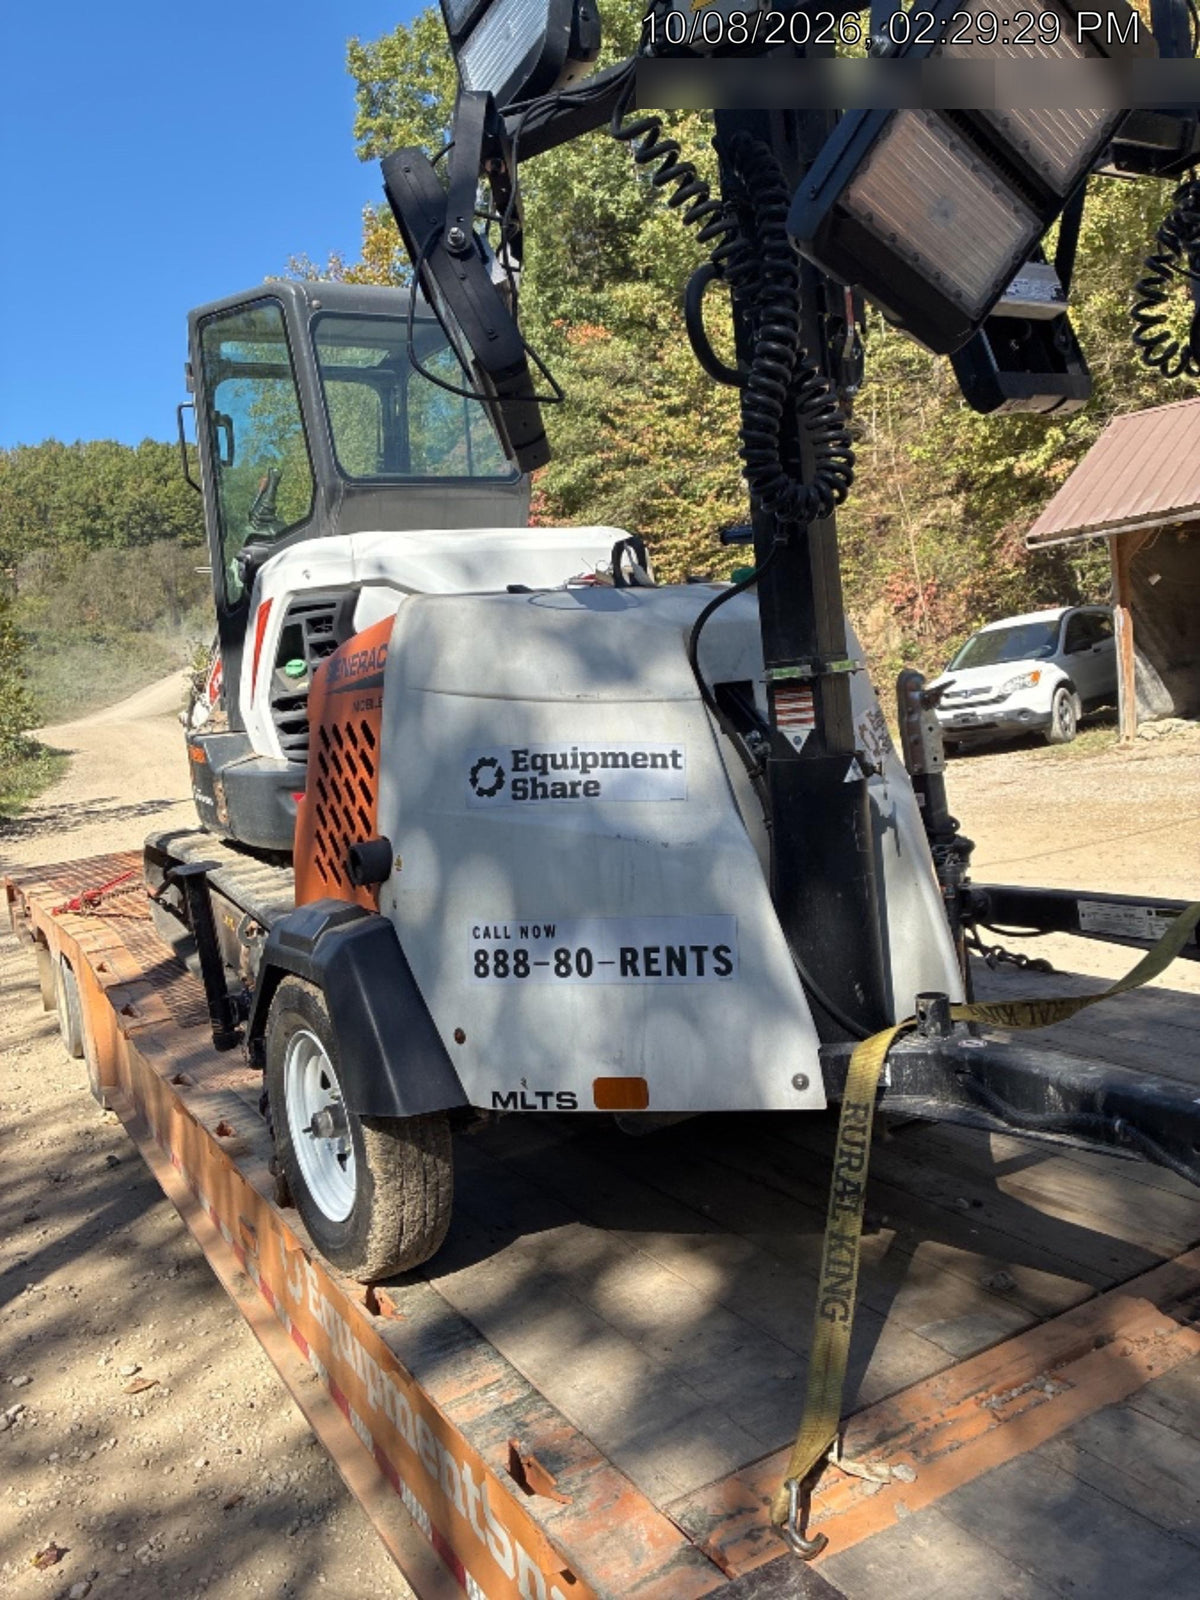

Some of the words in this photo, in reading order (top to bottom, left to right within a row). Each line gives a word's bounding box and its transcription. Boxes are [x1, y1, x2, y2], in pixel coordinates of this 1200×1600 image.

[511, 747, 683, 776] Equipment
[511, 776, 601, 801] Share
[472, 925, 511, 940] CALL
[519, 924, 556, 939] NOW
[491, 1091, 578, 1110] MLTS
[830, 1102, 871, 1222] RURAL
[819, 1233, 858, 1324] KING
